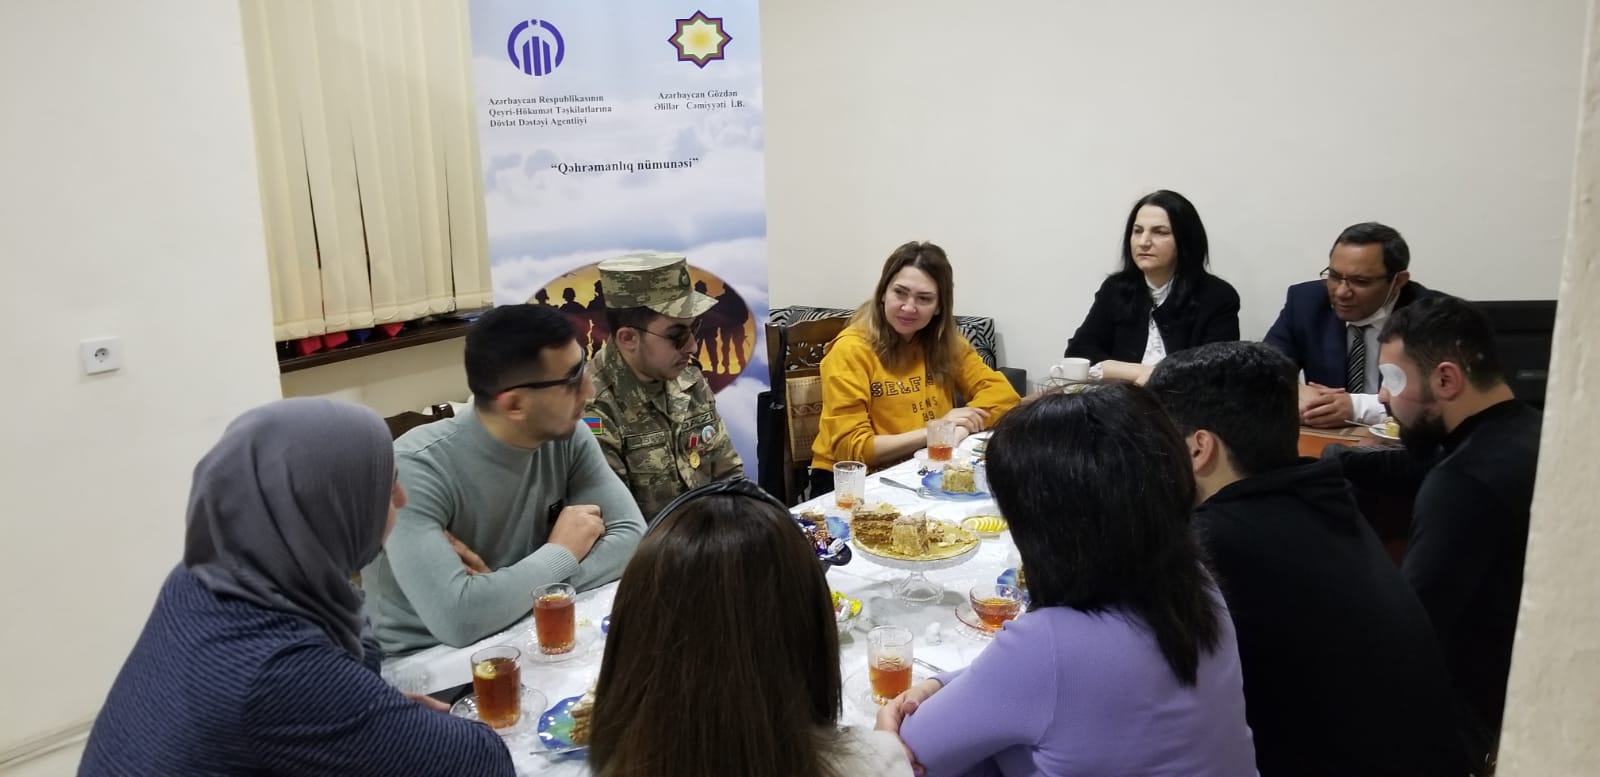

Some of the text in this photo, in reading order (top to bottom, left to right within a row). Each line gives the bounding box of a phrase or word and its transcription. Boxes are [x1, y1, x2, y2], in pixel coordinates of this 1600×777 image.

[488, 94, 604, 106] Azərbaycan Respublikasının
[551, 116, 587, 127] Agentliyi
[871, 376, 922, 397] SELF
